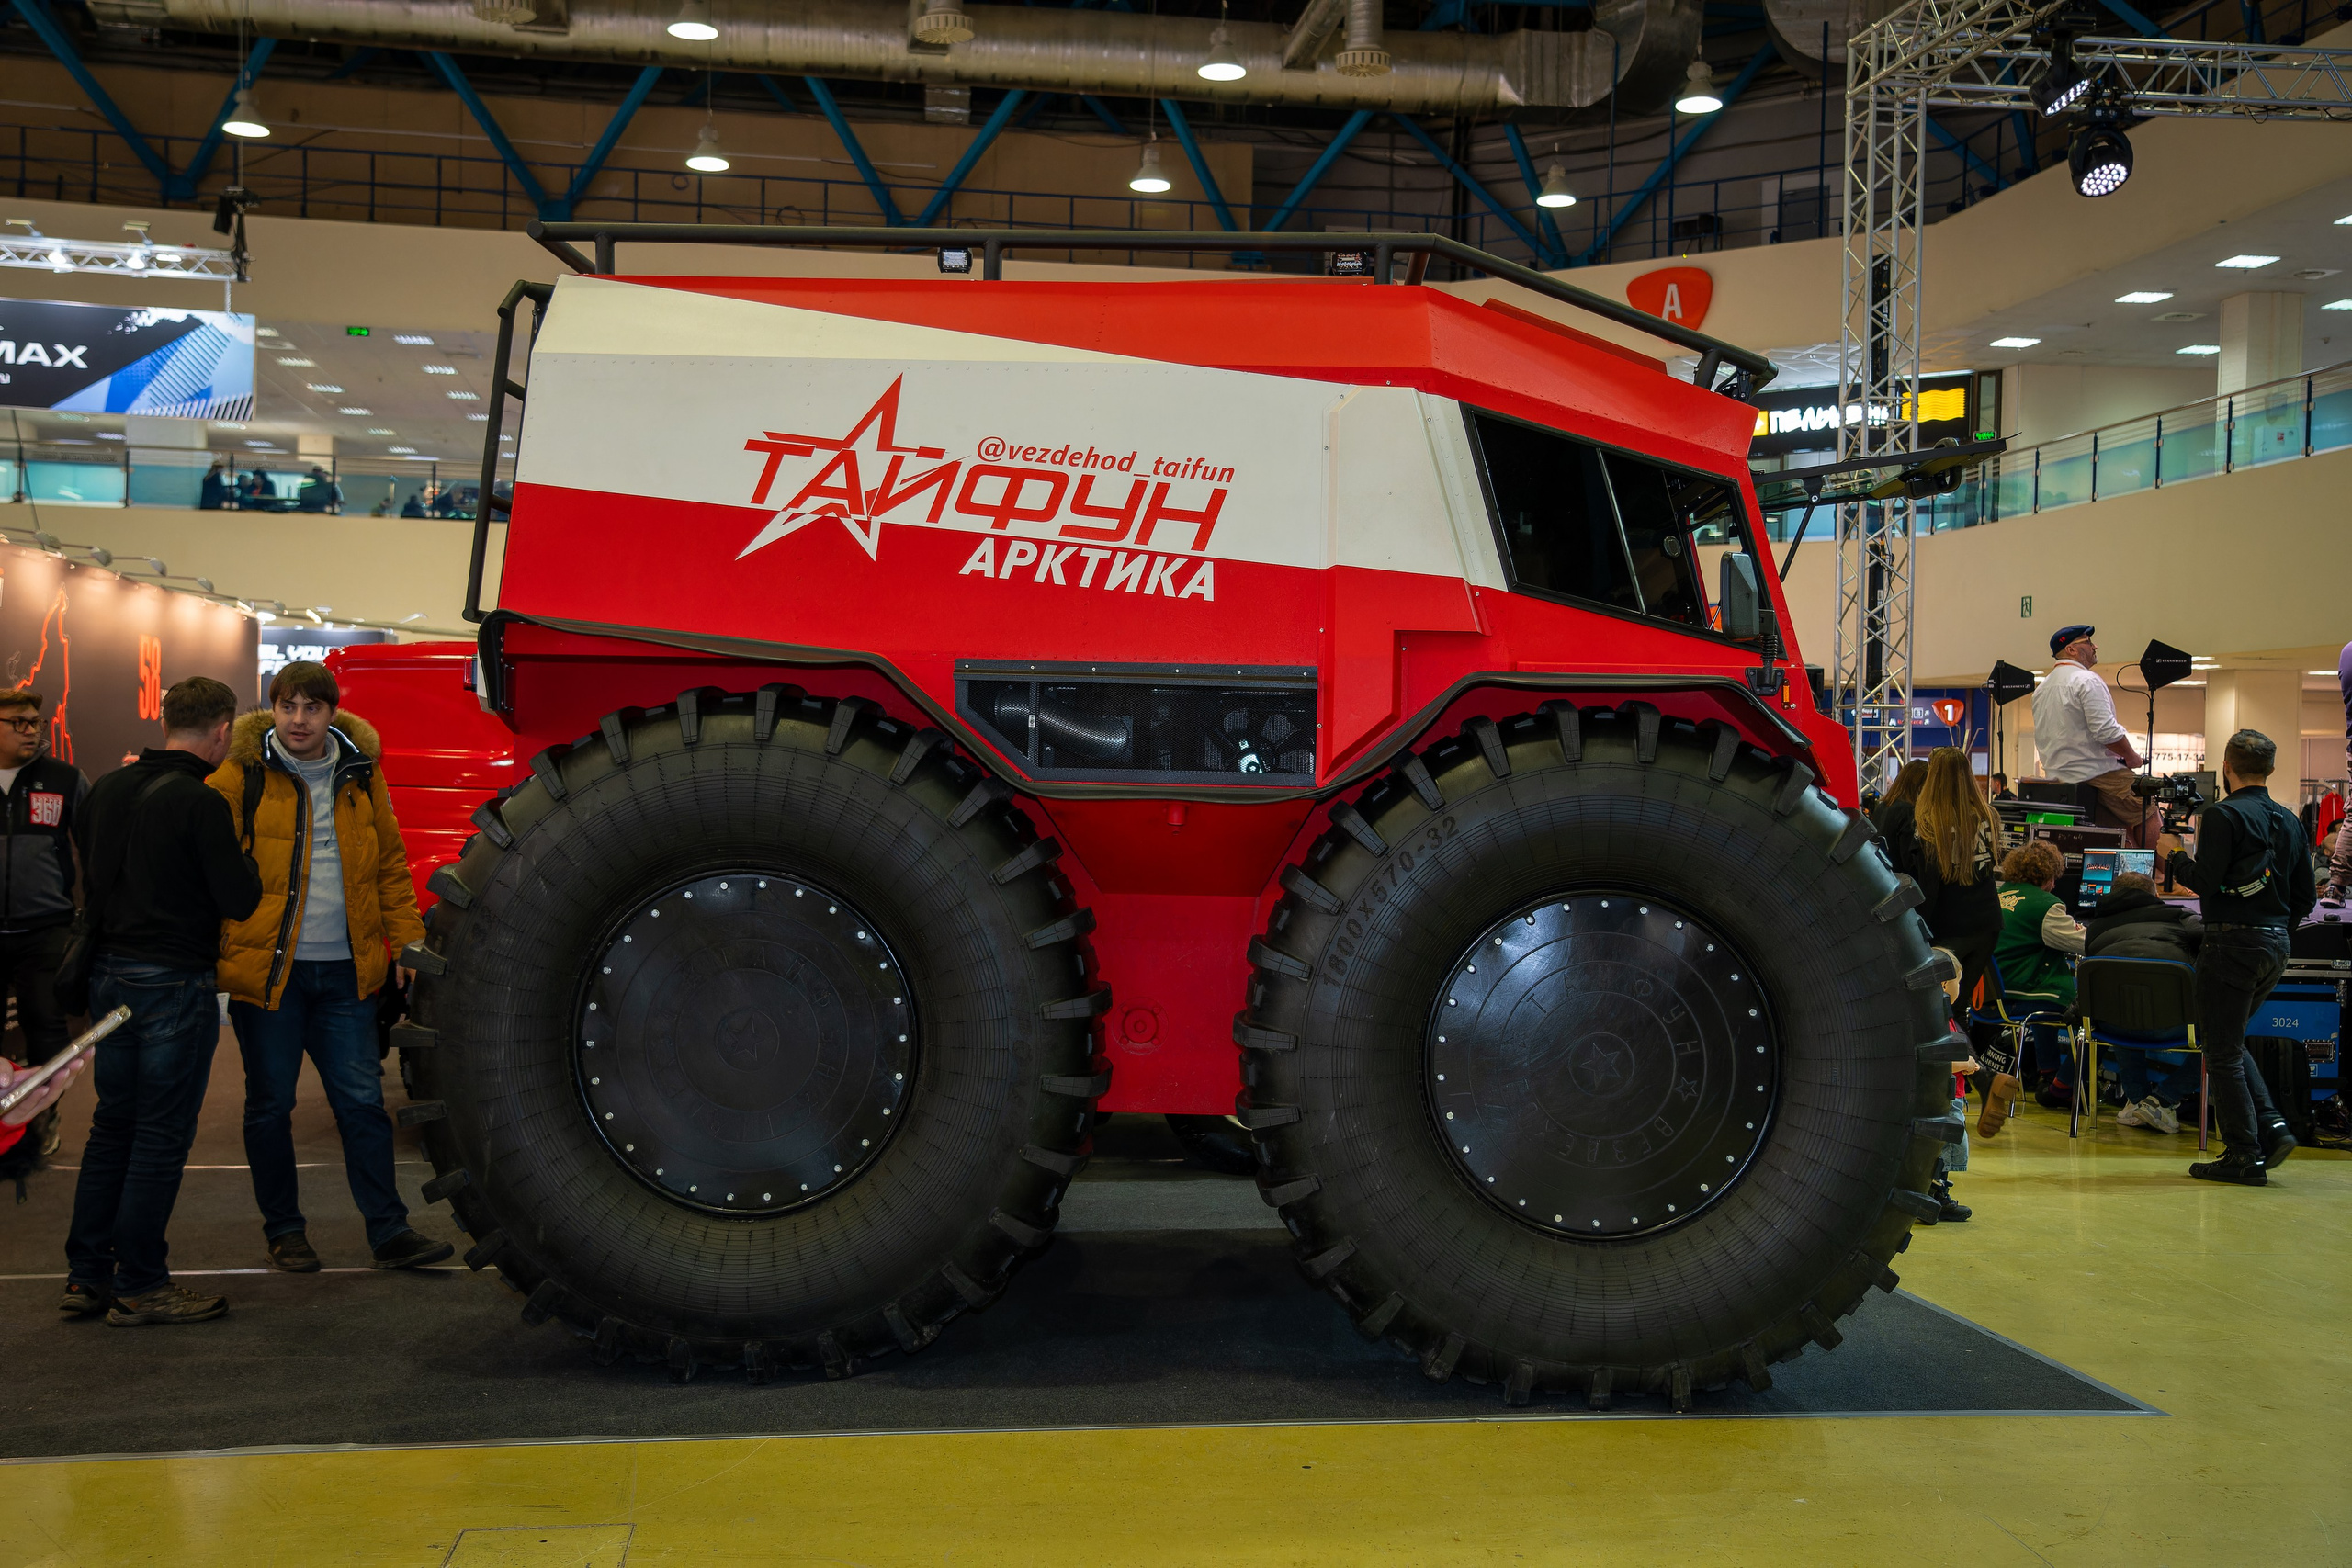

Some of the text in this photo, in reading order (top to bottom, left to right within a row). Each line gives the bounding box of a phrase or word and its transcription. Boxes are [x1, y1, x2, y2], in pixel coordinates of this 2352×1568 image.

[977, 436, 1235, 483] @vezdehod_taifun
[744, 439, 1228, 552] ТАЙФУН
[958, 536, 1215, 602] АРКТИКА
[1944, 704, 1954, 721] 1
[2271, 1016, 2300, 1028] 3024
